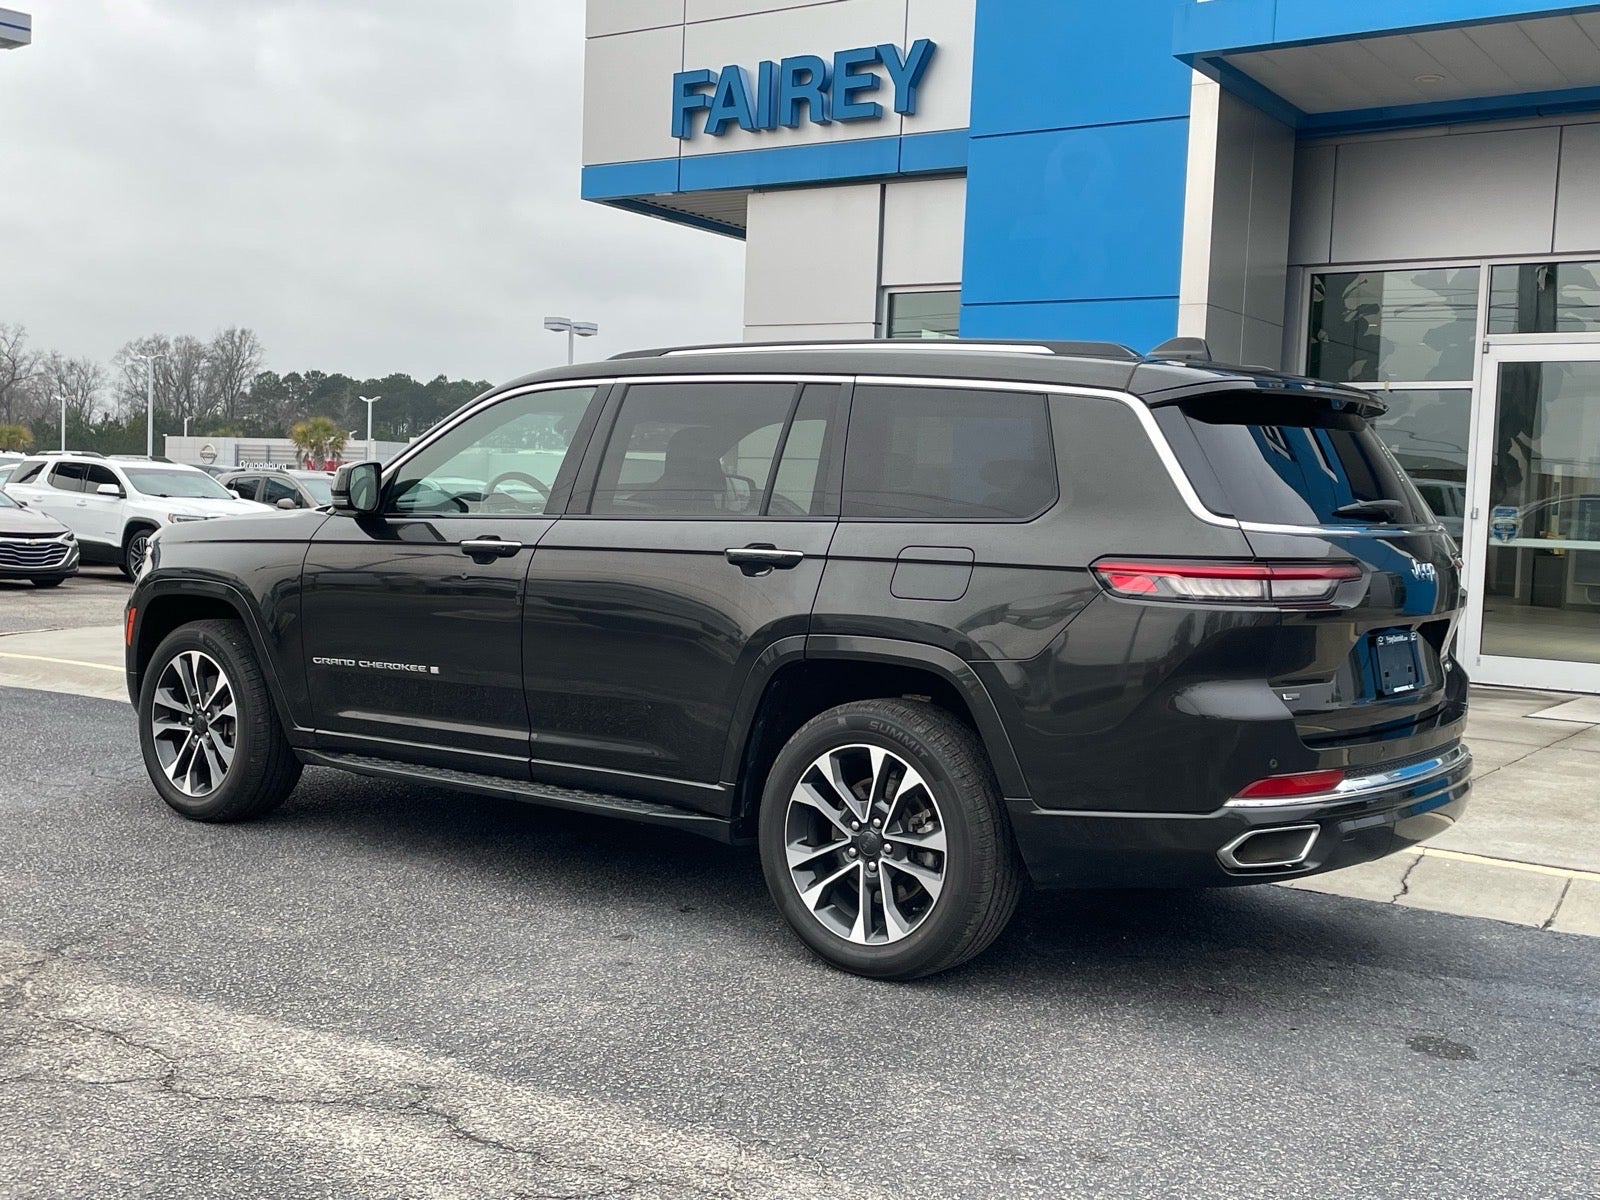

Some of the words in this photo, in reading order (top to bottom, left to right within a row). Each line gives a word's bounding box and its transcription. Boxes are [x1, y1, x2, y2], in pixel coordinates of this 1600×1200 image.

[671, 38, 937, 140] FAIREY
[1411, 558, 1436, 582] Jeep
[312, 657, 356, 667] GRAND
[358, 660, 428, 673] CHEROKEE
